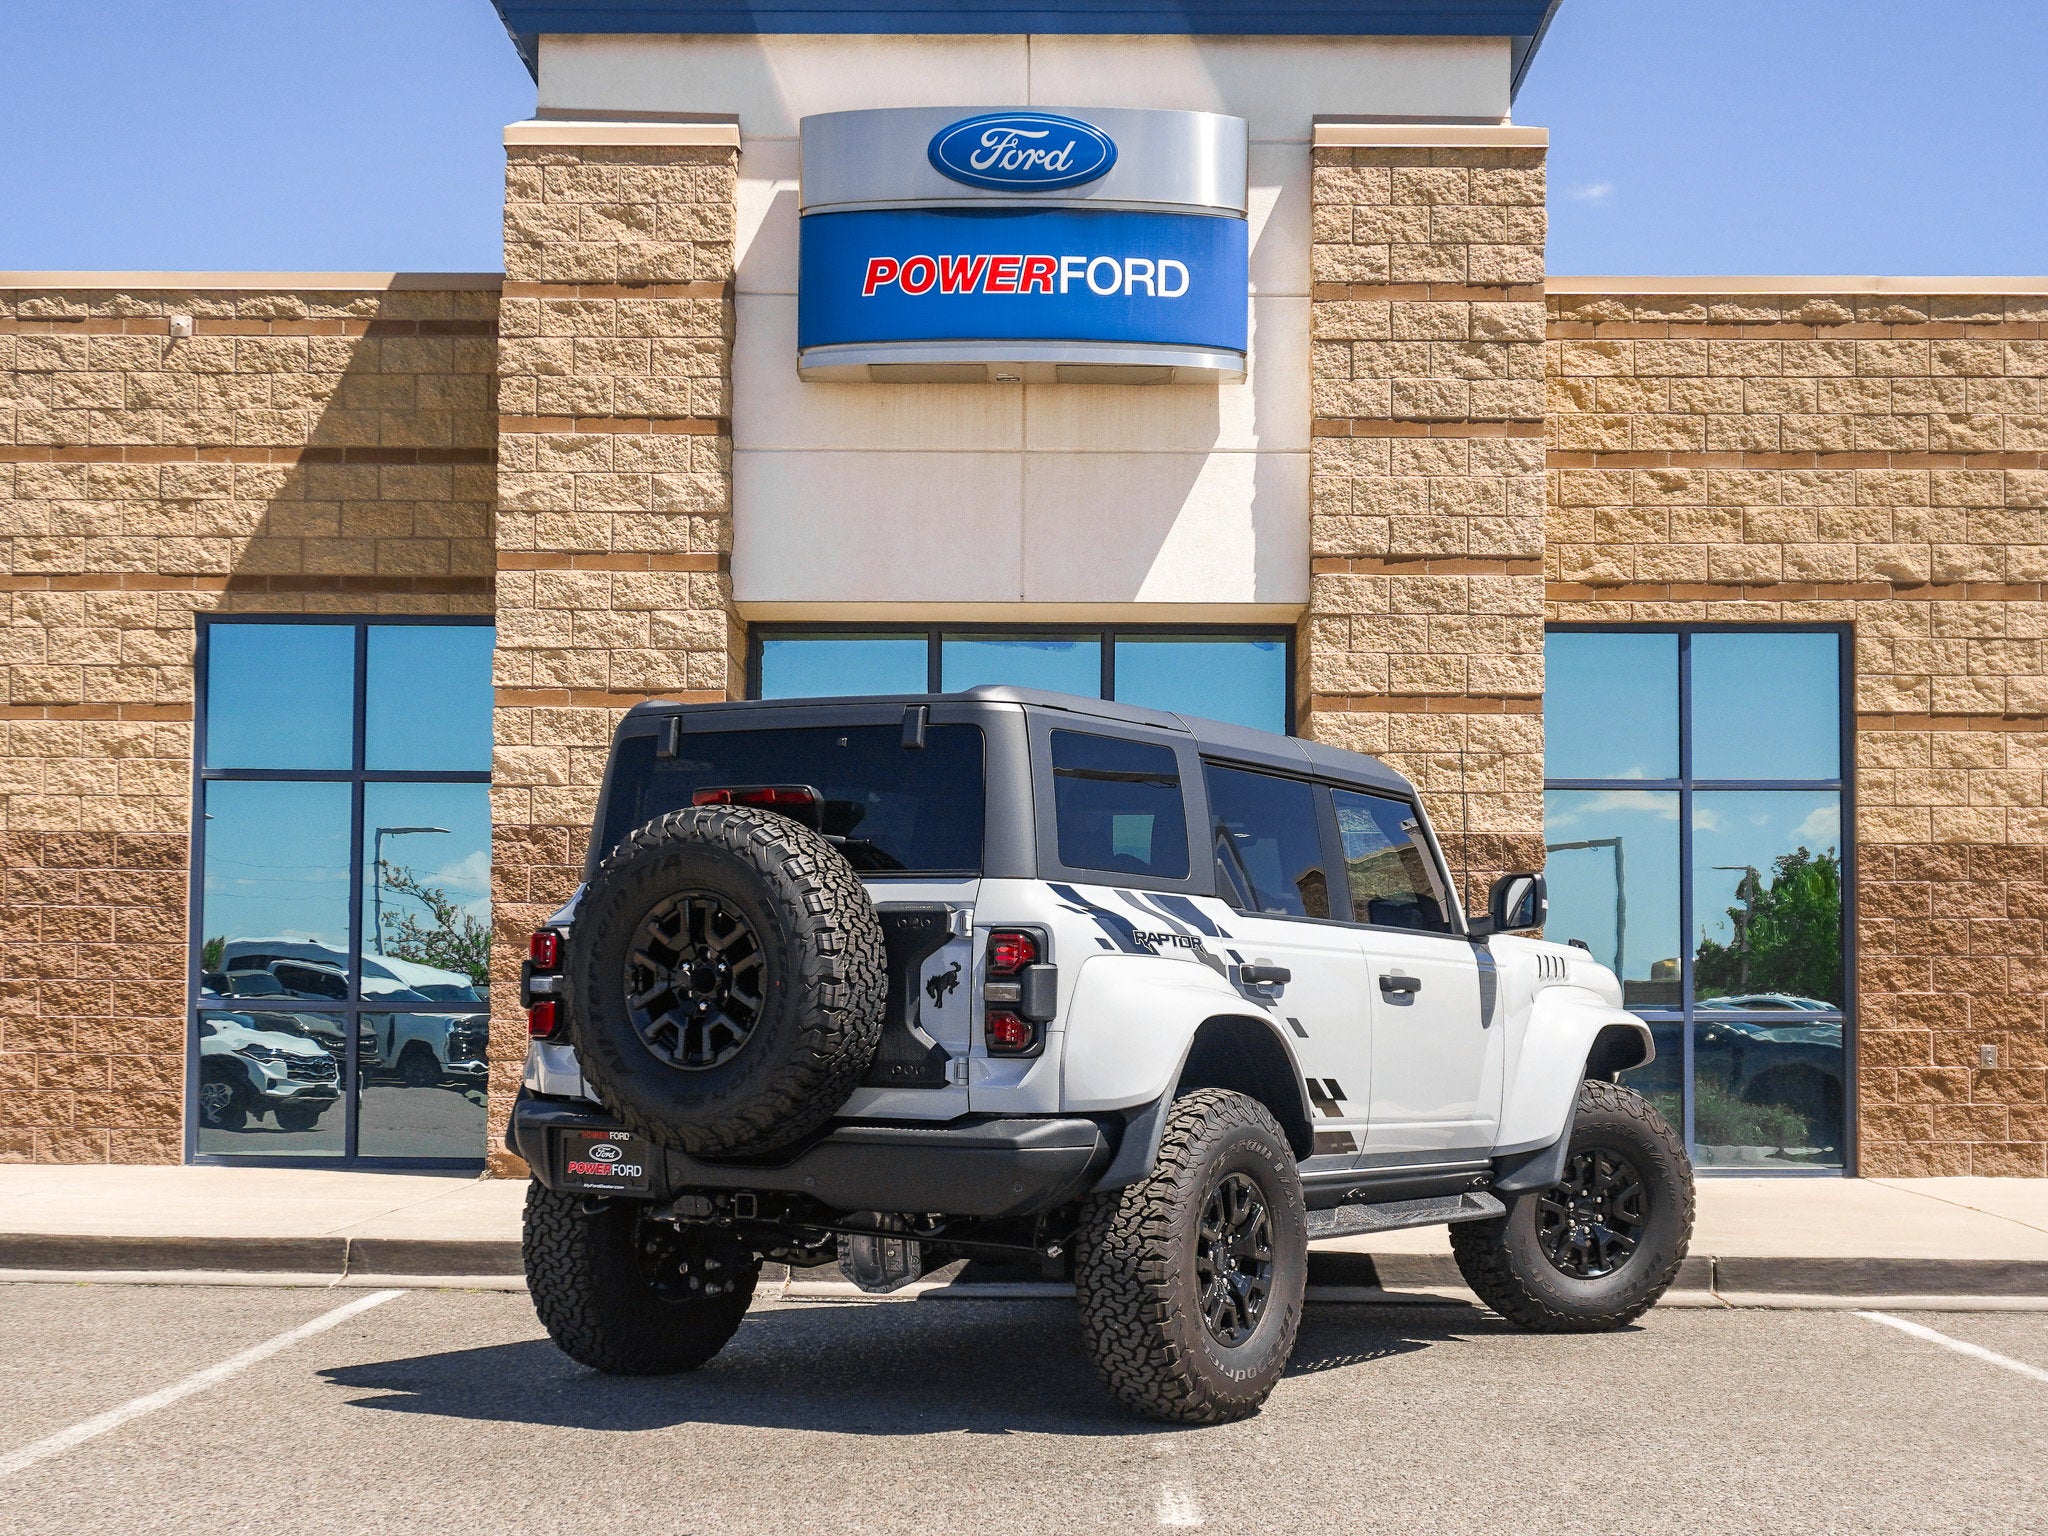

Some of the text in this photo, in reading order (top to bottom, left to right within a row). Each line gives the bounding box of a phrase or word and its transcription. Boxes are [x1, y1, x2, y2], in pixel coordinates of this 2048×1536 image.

[970, 127, 1076, 172] Ford
[862, 255, 1190, 298] POWERFORD
[1133, 930, 1206, 953] RAPTOR
[595, 1146, 616, 1159] Ford
